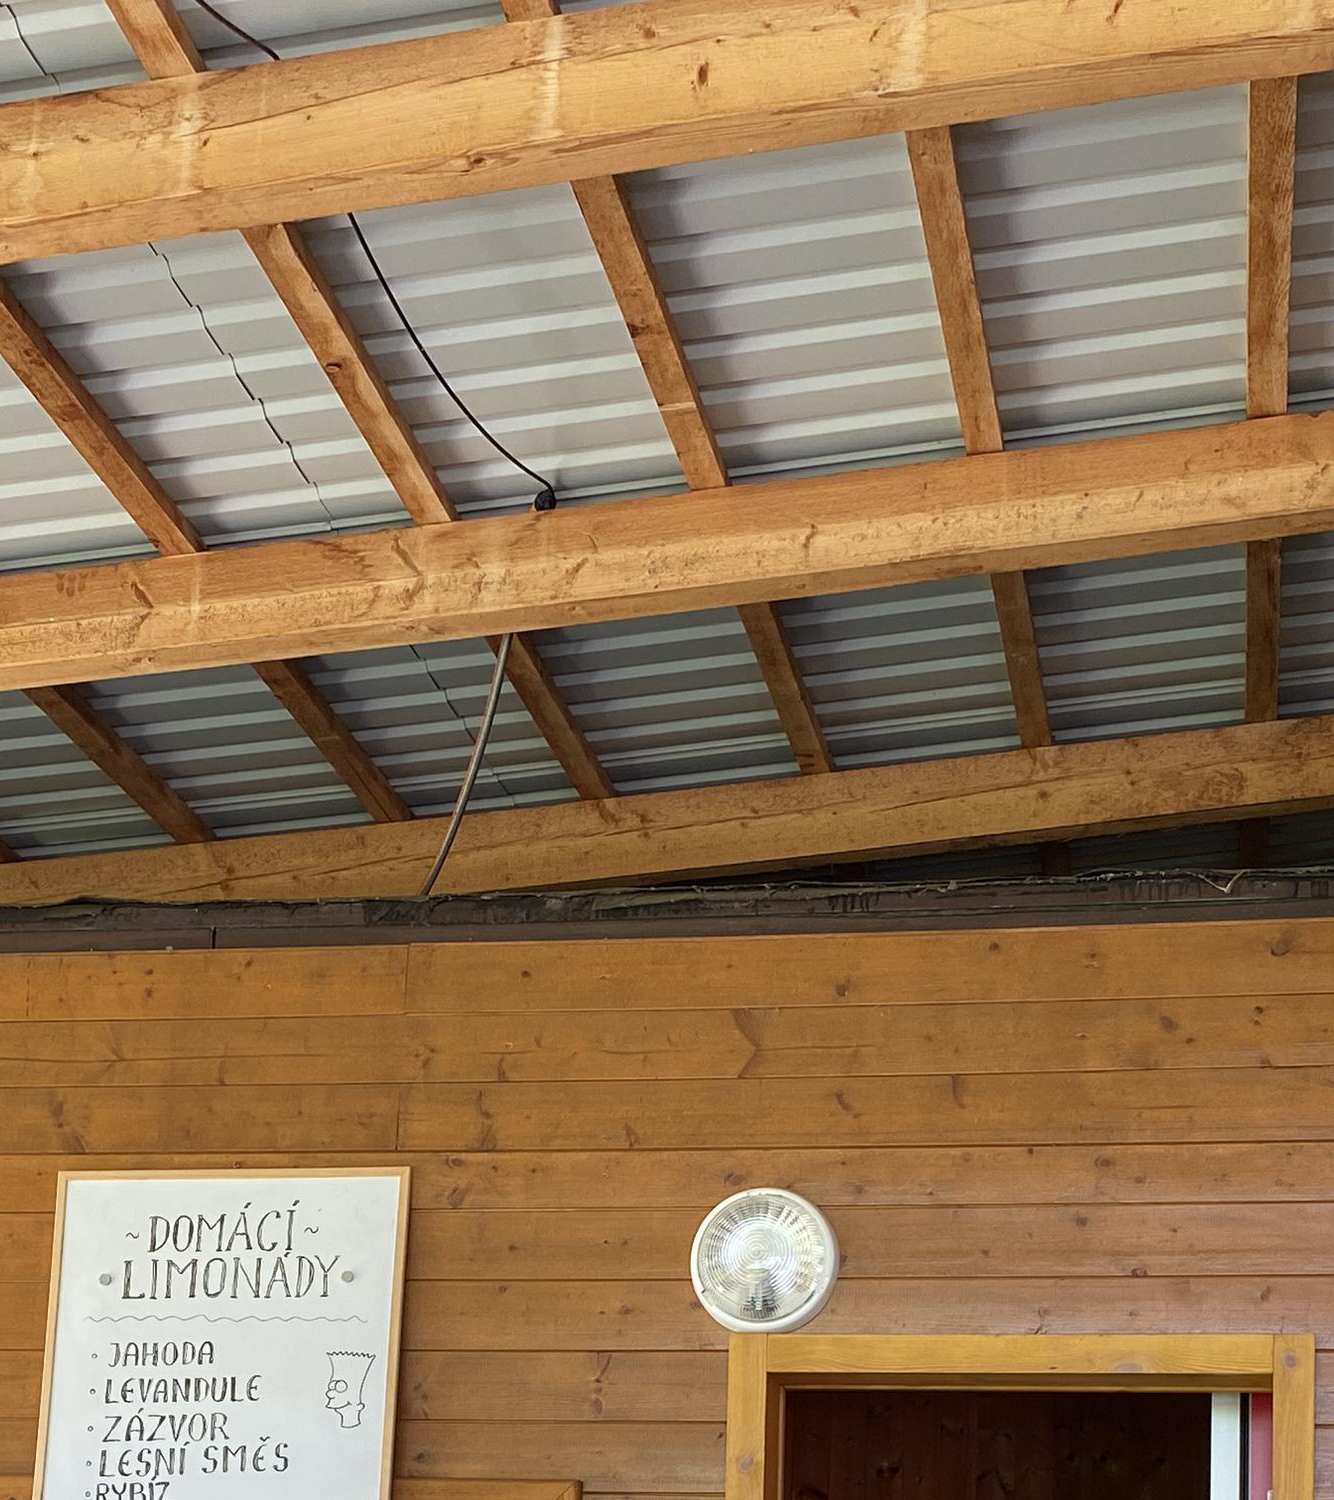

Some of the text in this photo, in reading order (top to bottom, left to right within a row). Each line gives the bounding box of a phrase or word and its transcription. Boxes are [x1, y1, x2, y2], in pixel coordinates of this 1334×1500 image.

[147, 1199, 300, 1252] DOMÁCÍ
[122, 1251, 341, 1300] LIMONÁDY
[108, 1340, 215, 1367] JAHODA
[104, 1374, 263, 1404] LEVANDULE
[102, 1407, 230, 1443] ZÁZVOR
[99, 1436, 290, 1478] LESNÍ SMĚS
